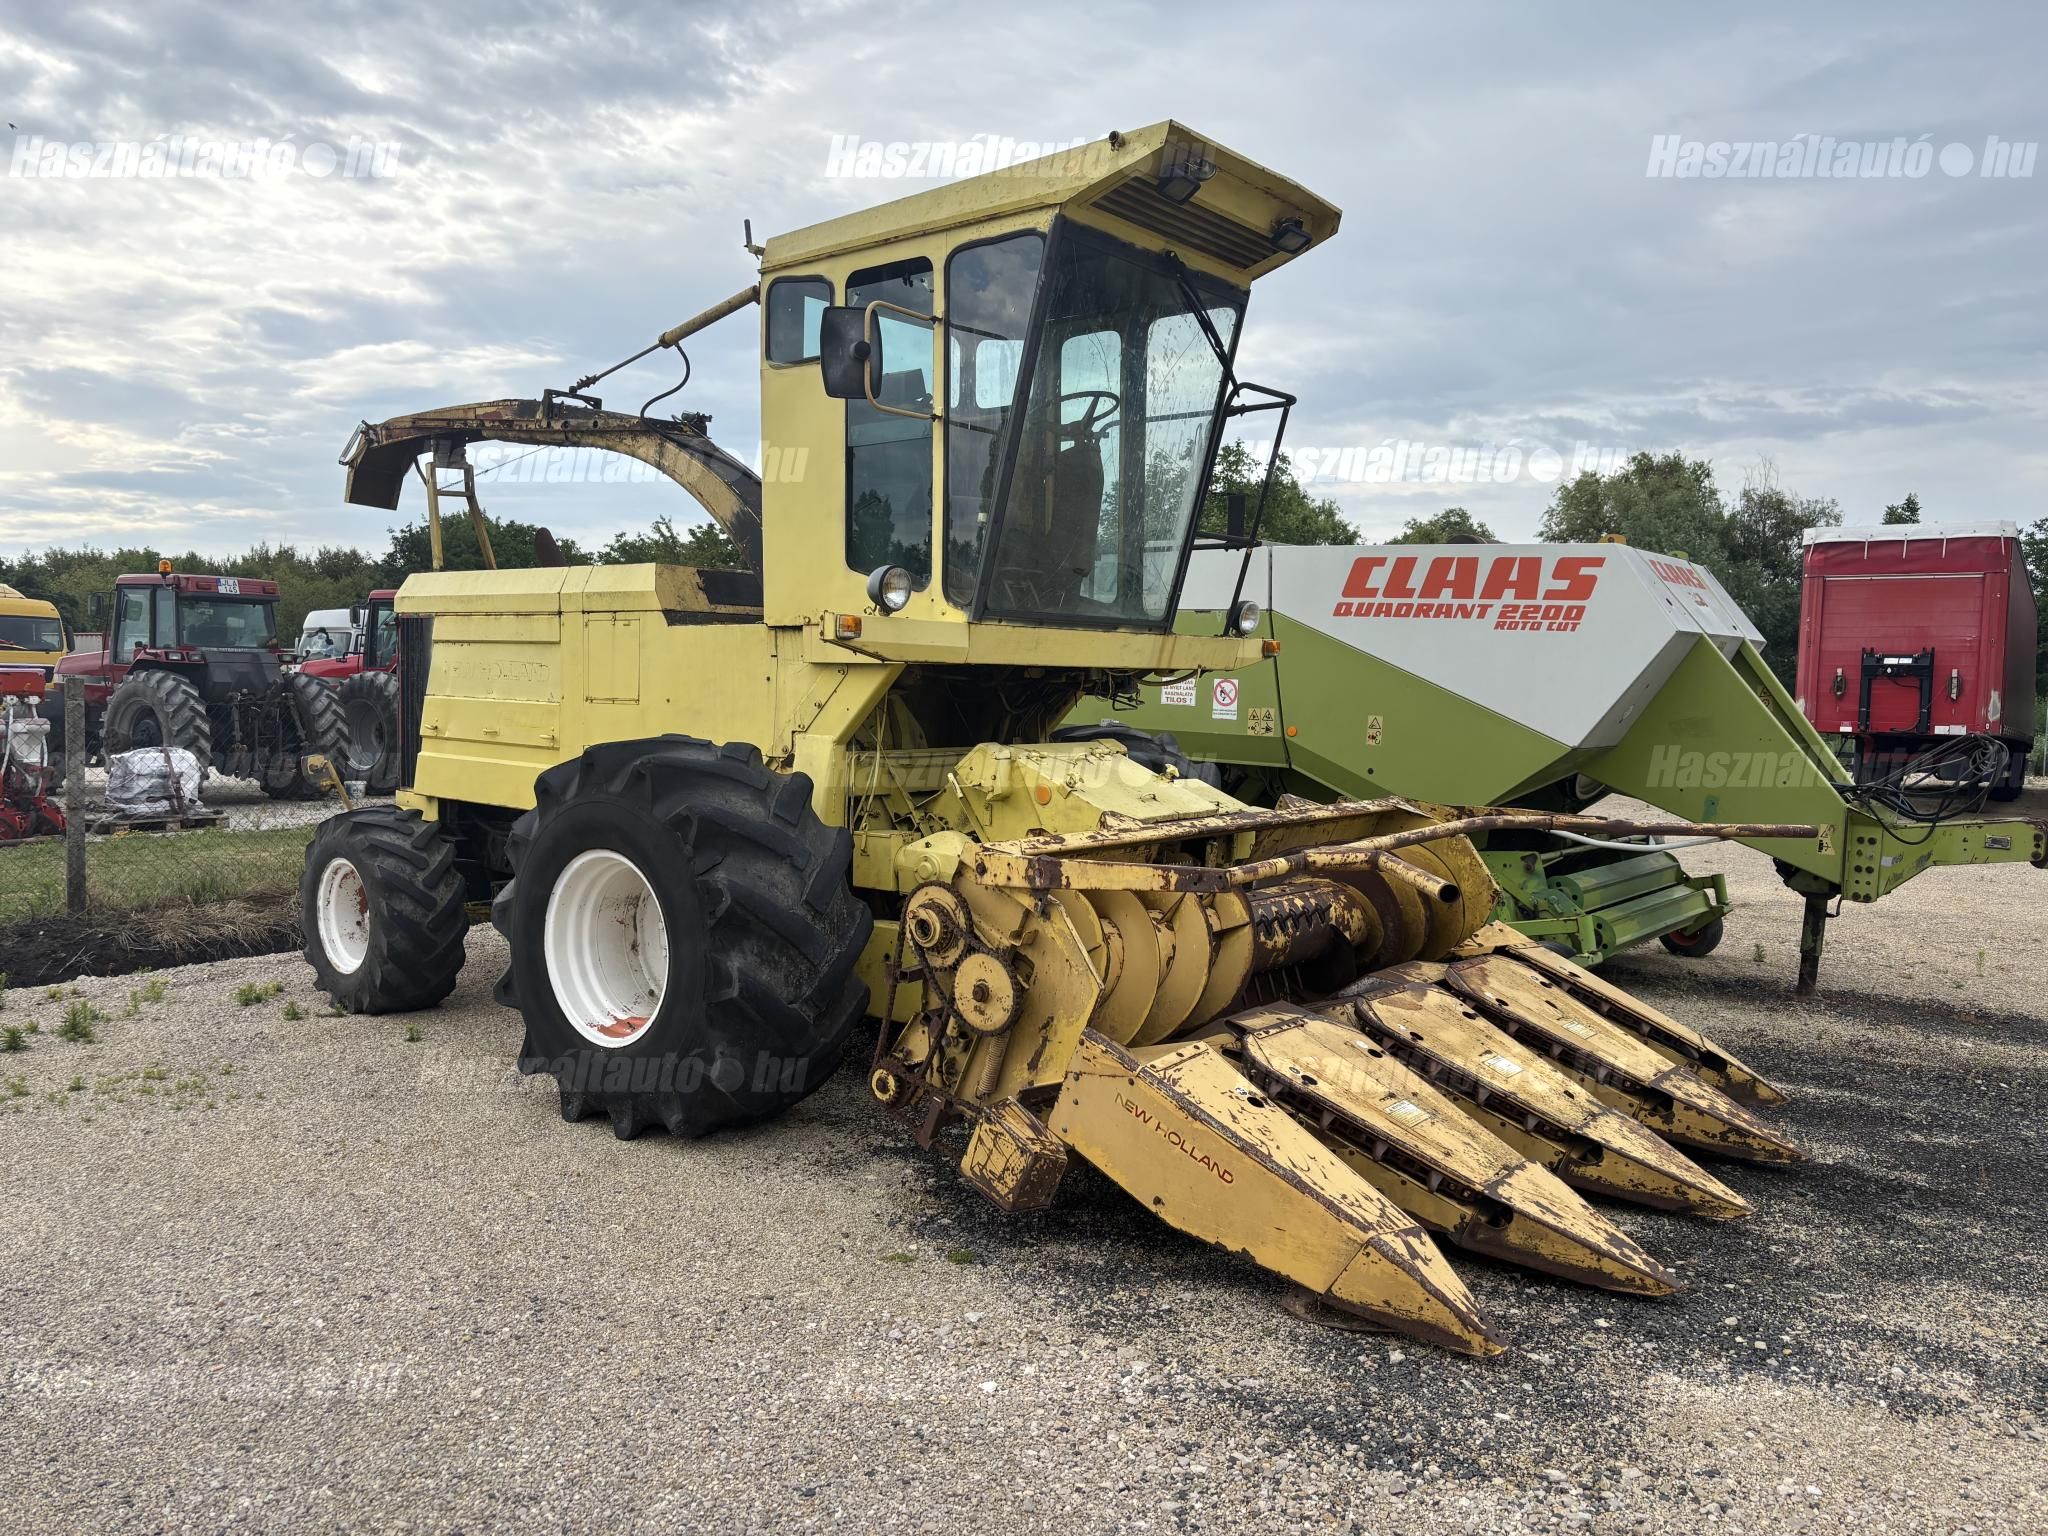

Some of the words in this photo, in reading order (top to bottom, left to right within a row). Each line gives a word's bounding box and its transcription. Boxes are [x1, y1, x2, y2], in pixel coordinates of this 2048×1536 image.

[1341, 556, 1607, 601] CLAAS
[1332, 602, 1494, 620] QUADRANT
[1496, 604, 1587, 622] 2200
[1493, 620, 1543, 632] ROTO
[1545, 621, 1581, 633] CUT
[1114, 1092, 1153, 1124] NEW
[1155, 1121, 1235, 1184] HOLLAND
